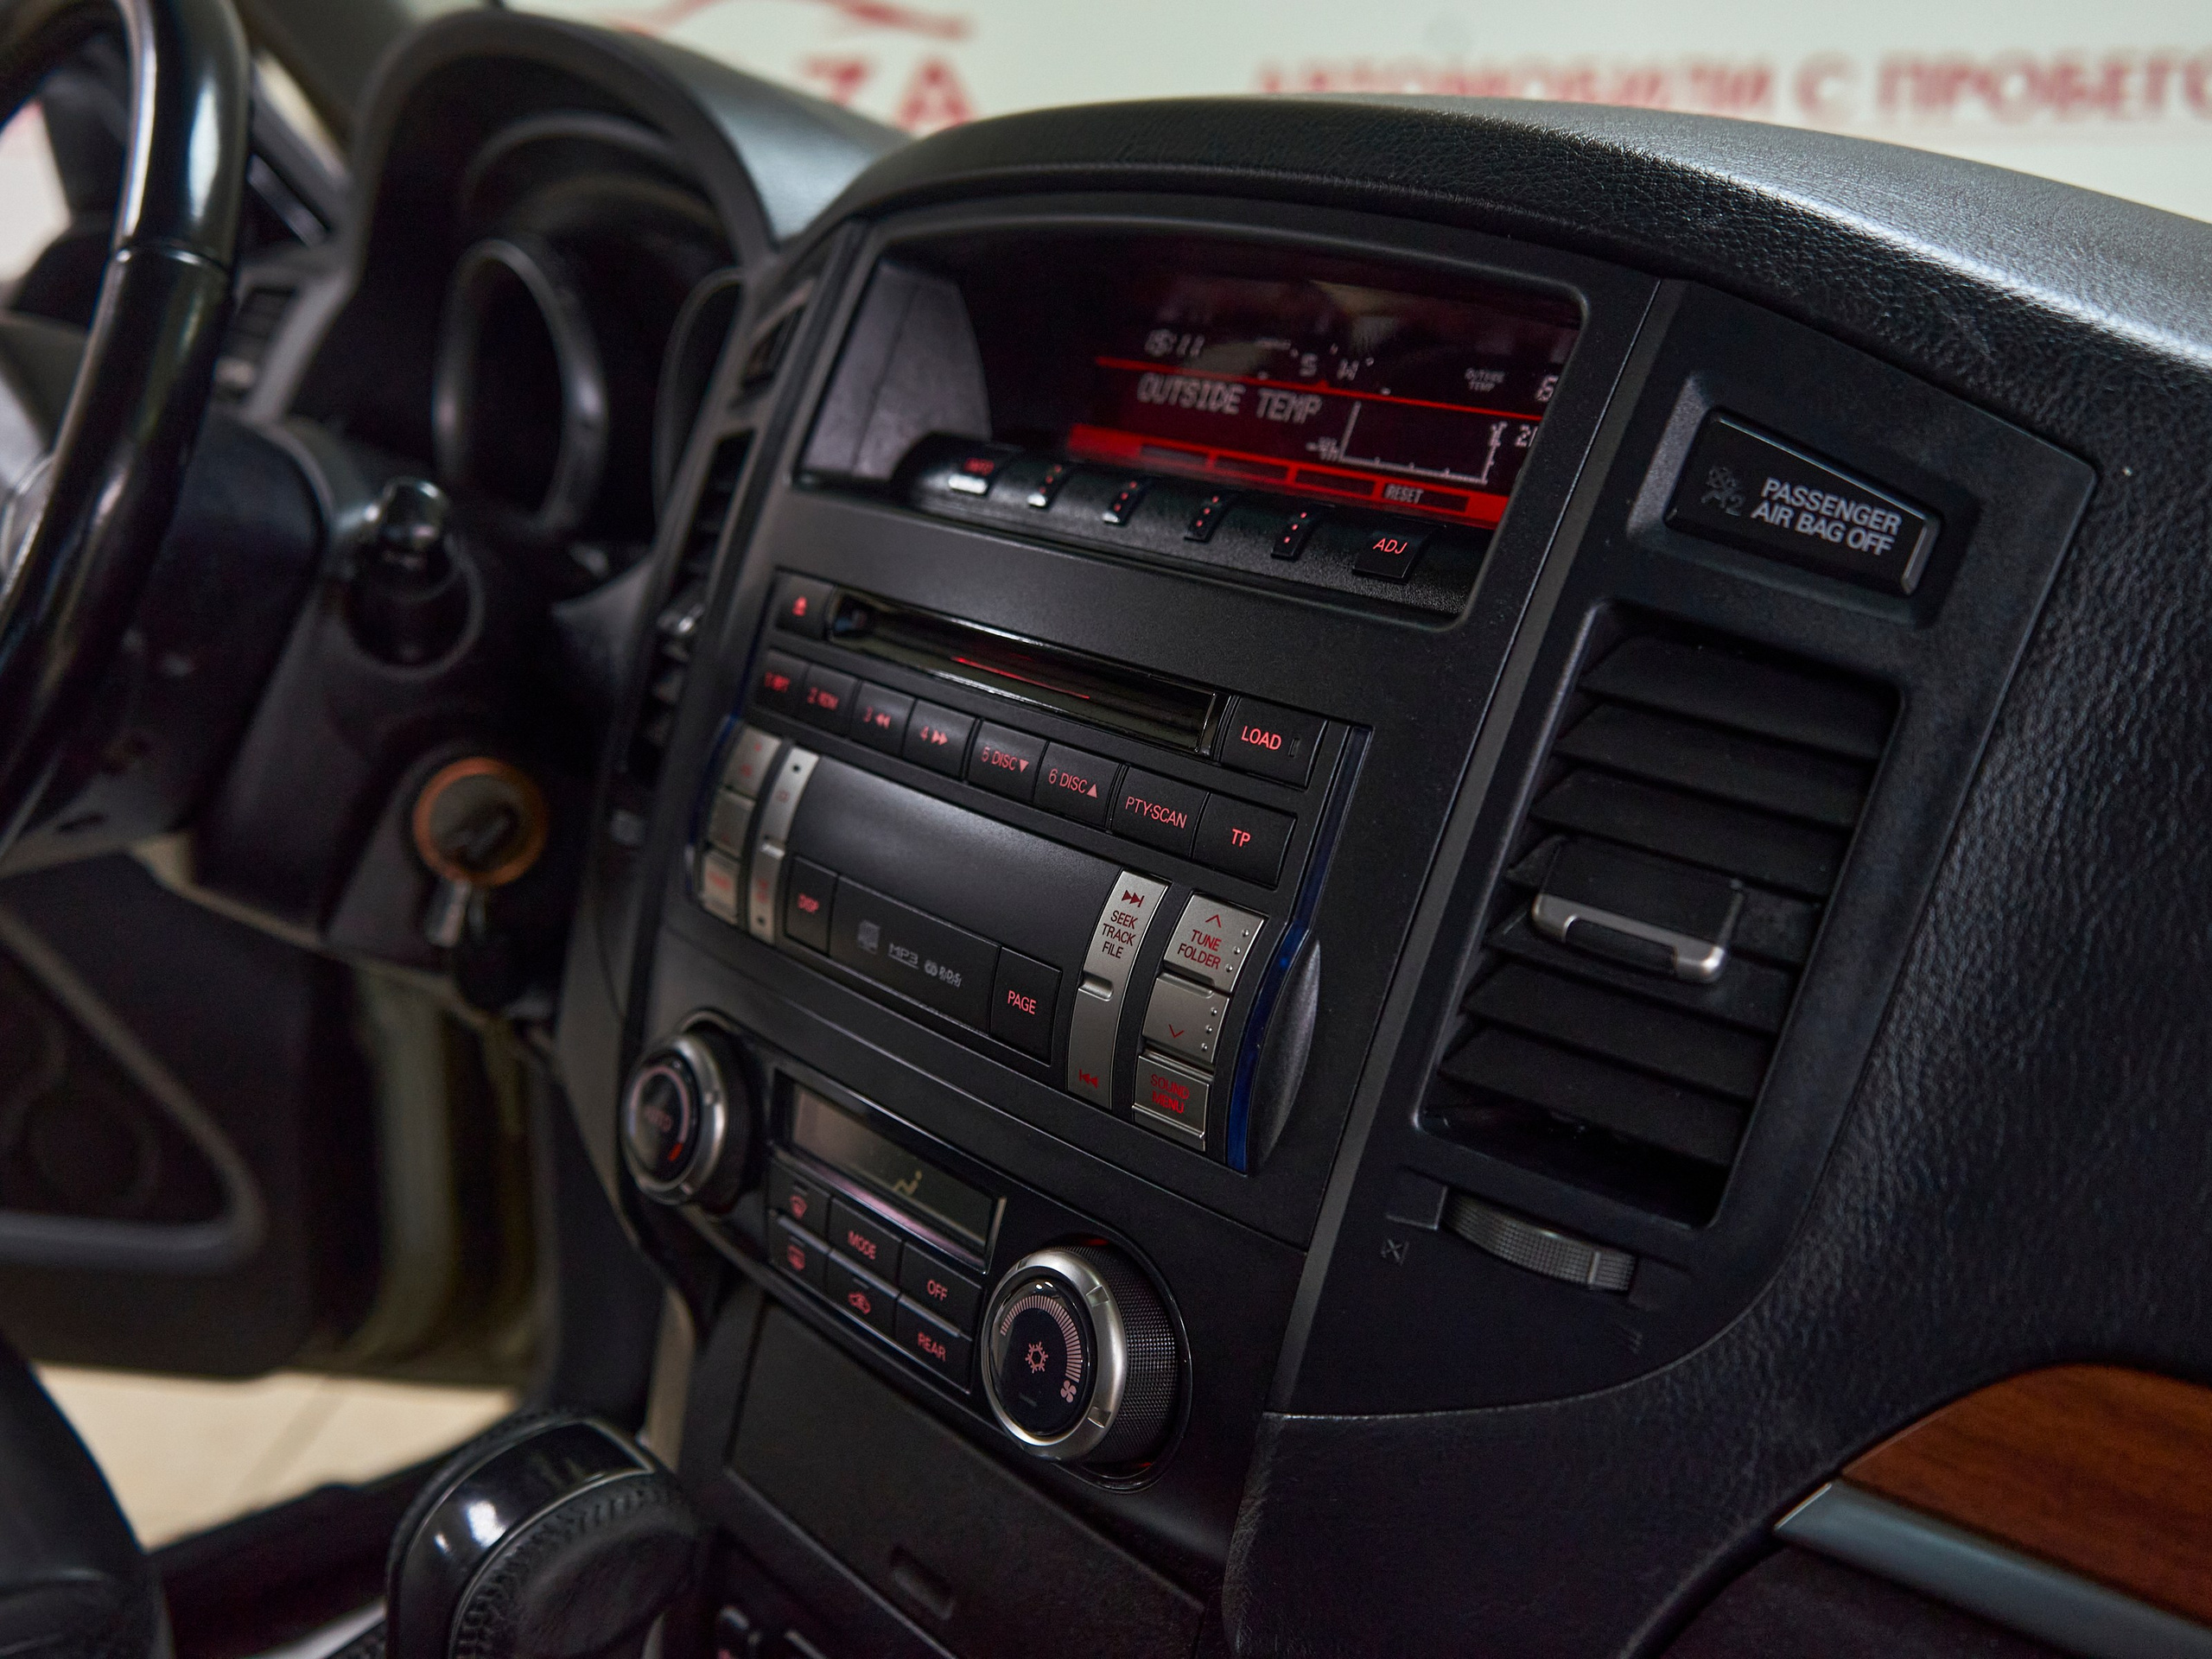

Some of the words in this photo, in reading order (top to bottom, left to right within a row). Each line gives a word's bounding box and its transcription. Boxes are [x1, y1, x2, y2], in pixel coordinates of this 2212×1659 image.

[1137, 372, 1246, 416] OUTSIDE
[1256, 387, 1323, 424] TEMP
[1384, 482, 1425, 504] RESET
[1760, 477, 1902, 535] PASSENGER
[1751, 501, 1793, 529] AIR
[1795, 512, 1845, 543] BAG
[1847, 527, 1896, 556] OFF
[1372, 537, 1408, 555] ADJ
[919, 726, 930, 741] 4
[1241, 725, 1283, 751] LOAD
[981, 746, 991, 763] 5
[992, 749, 1019, 772] DISC
[1048, 768, 1058, 785] 6
[1059, 772, 1088, 795] DISC
[1230, 828, 1252, 849] TP
[1110, 910, 1139, 930] SEEK
[1102, 923, 1137, 947] TRACK
[1192, 929, 1222, 951] TUNE
[887, 942, 919, 968] MP3
[1102, 941, 1124, 959] FILE
[1177, 943, 1222, 970] FOLDER
[1007, 989, 1037, 1015] PAGE
[1151, 1074, 1190, 1100] SOUND
[1152, 1090, 1185, 1114] MENU
[848, 1230, 877, 1260] MODE
[926, 1280, 949, 1301] OFF
[917, 1332, 946, 1362] REAR
